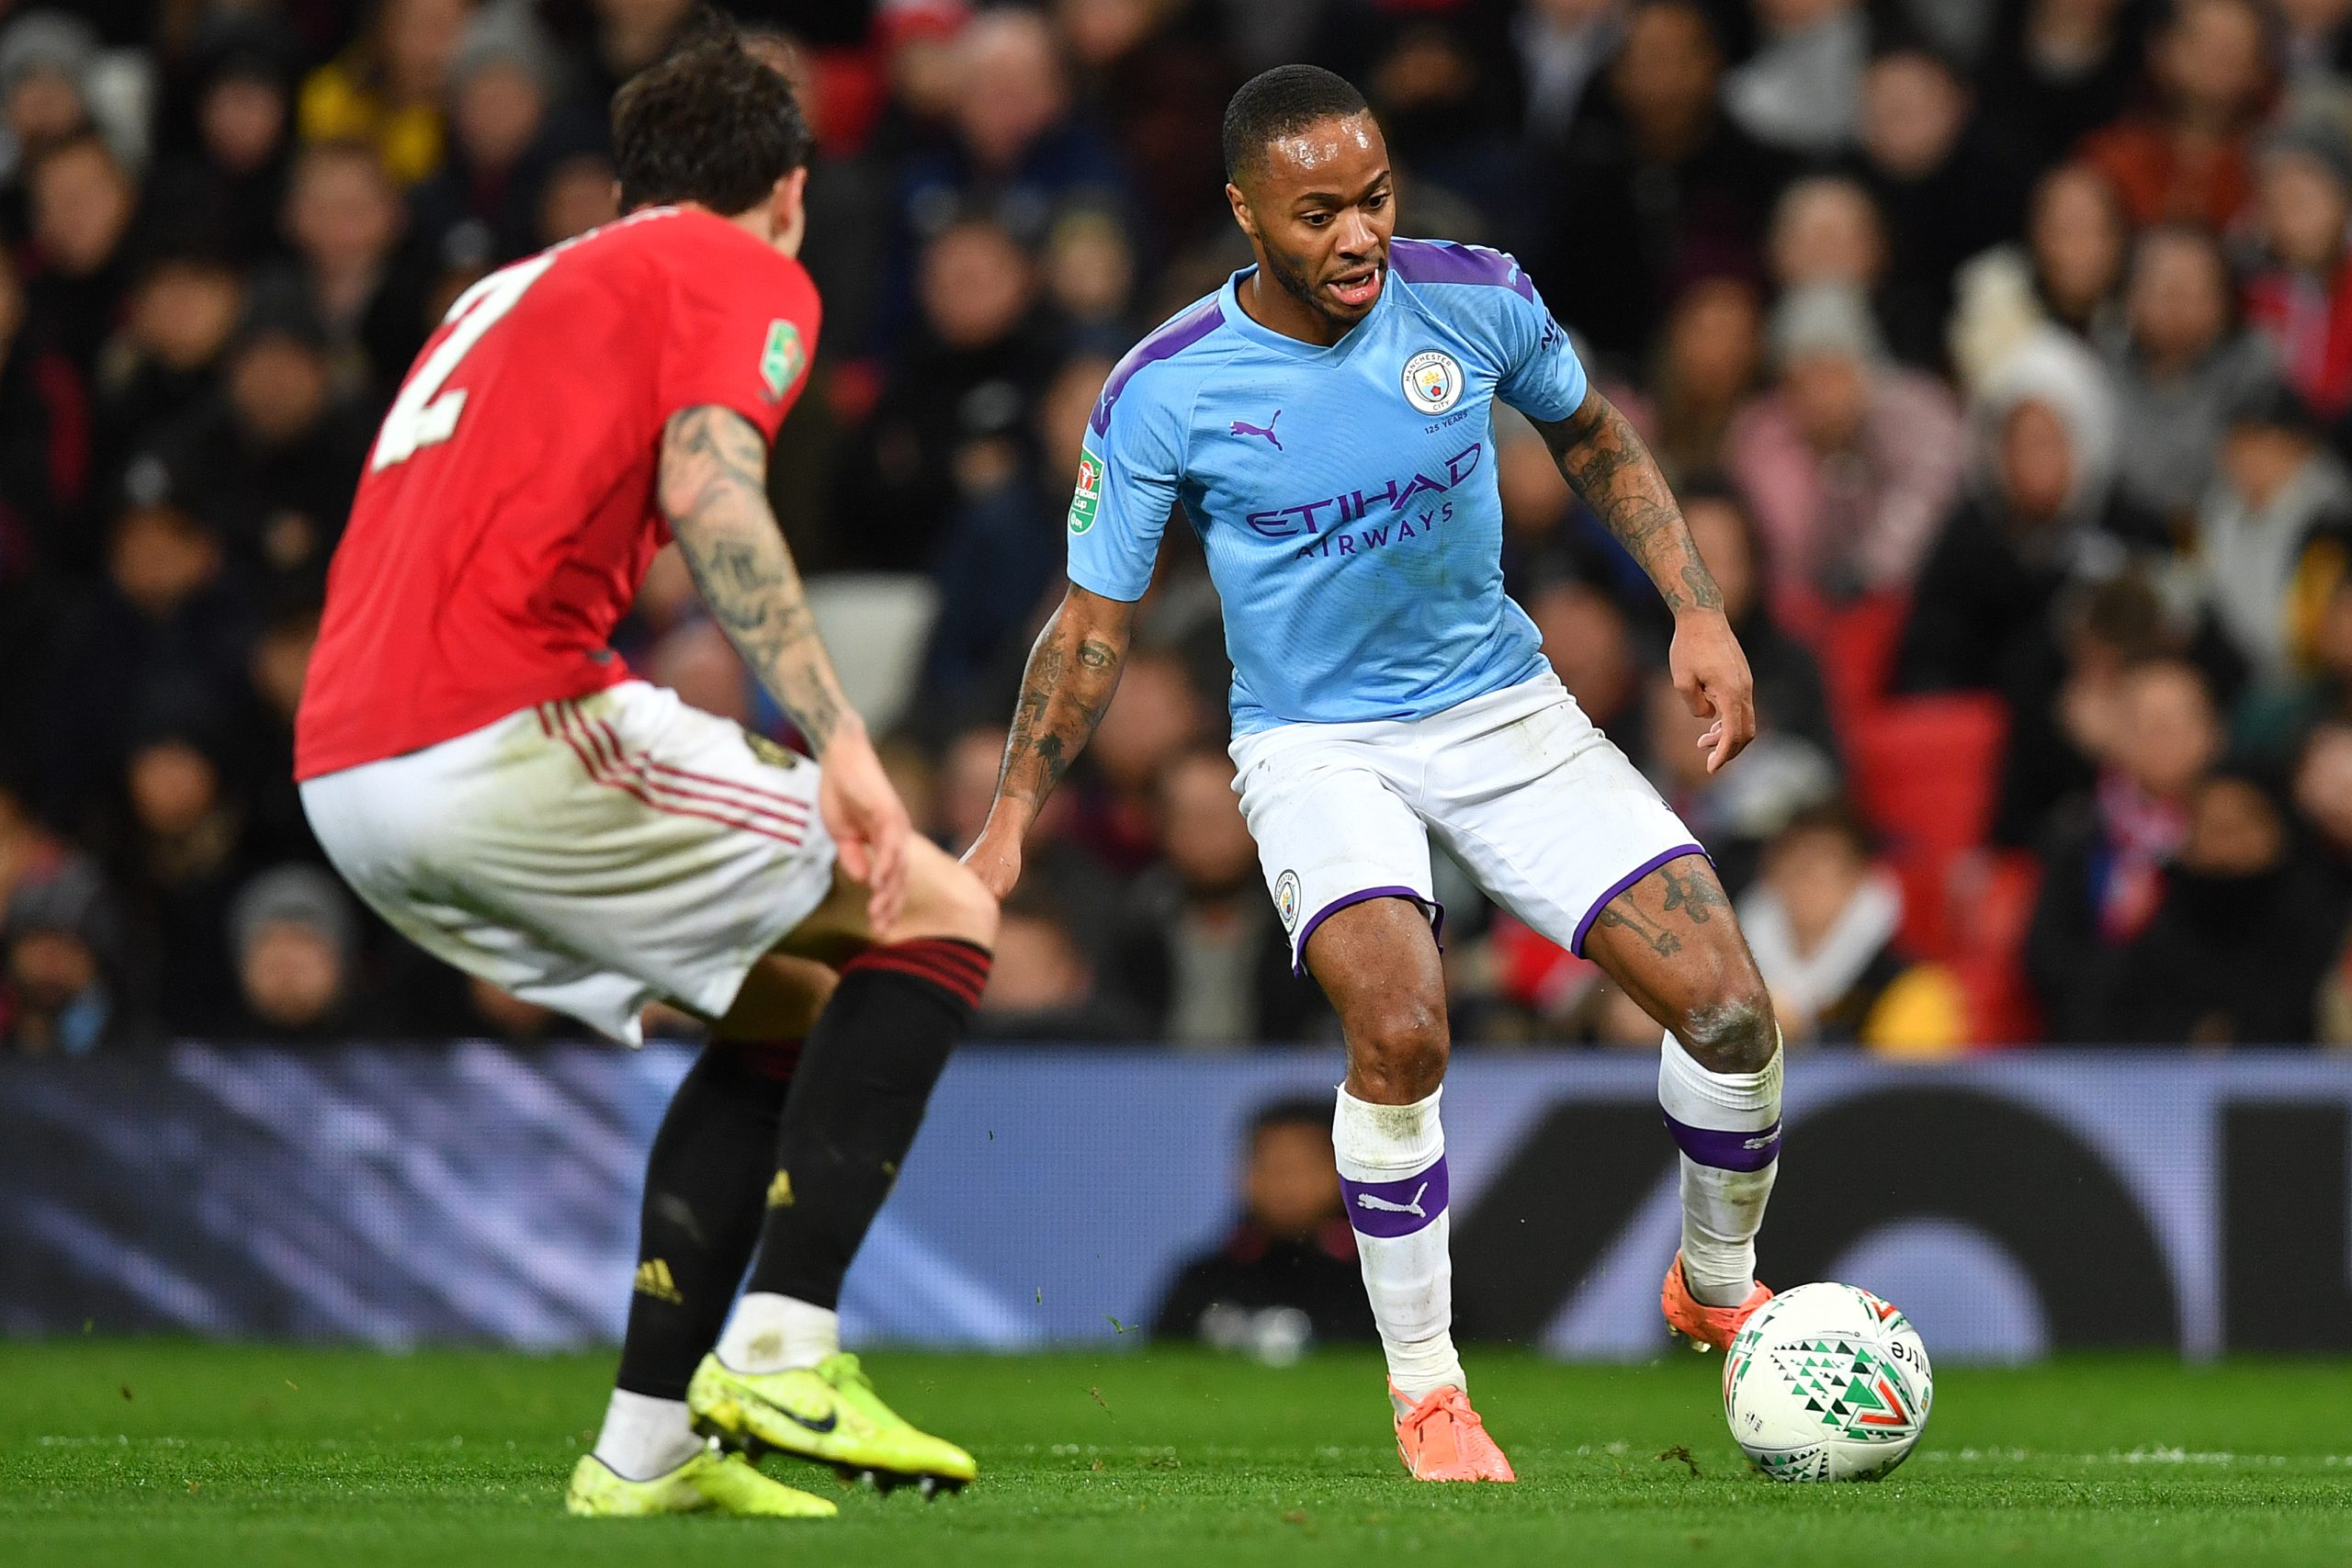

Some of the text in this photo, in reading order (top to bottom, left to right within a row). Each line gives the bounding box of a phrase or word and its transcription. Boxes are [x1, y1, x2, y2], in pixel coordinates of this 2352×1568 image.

[371, 251, 558, 474] 2
[1406, 354, 1452, 382] MANCHESTER
[1424, 411, 1469, 435] 125 YEARS
[1432, 400, 1450, 411] CITY
[1246, 442, 1482, 537] ETIHAD
[1295, 502, 1453, 560] AIRWAYS
